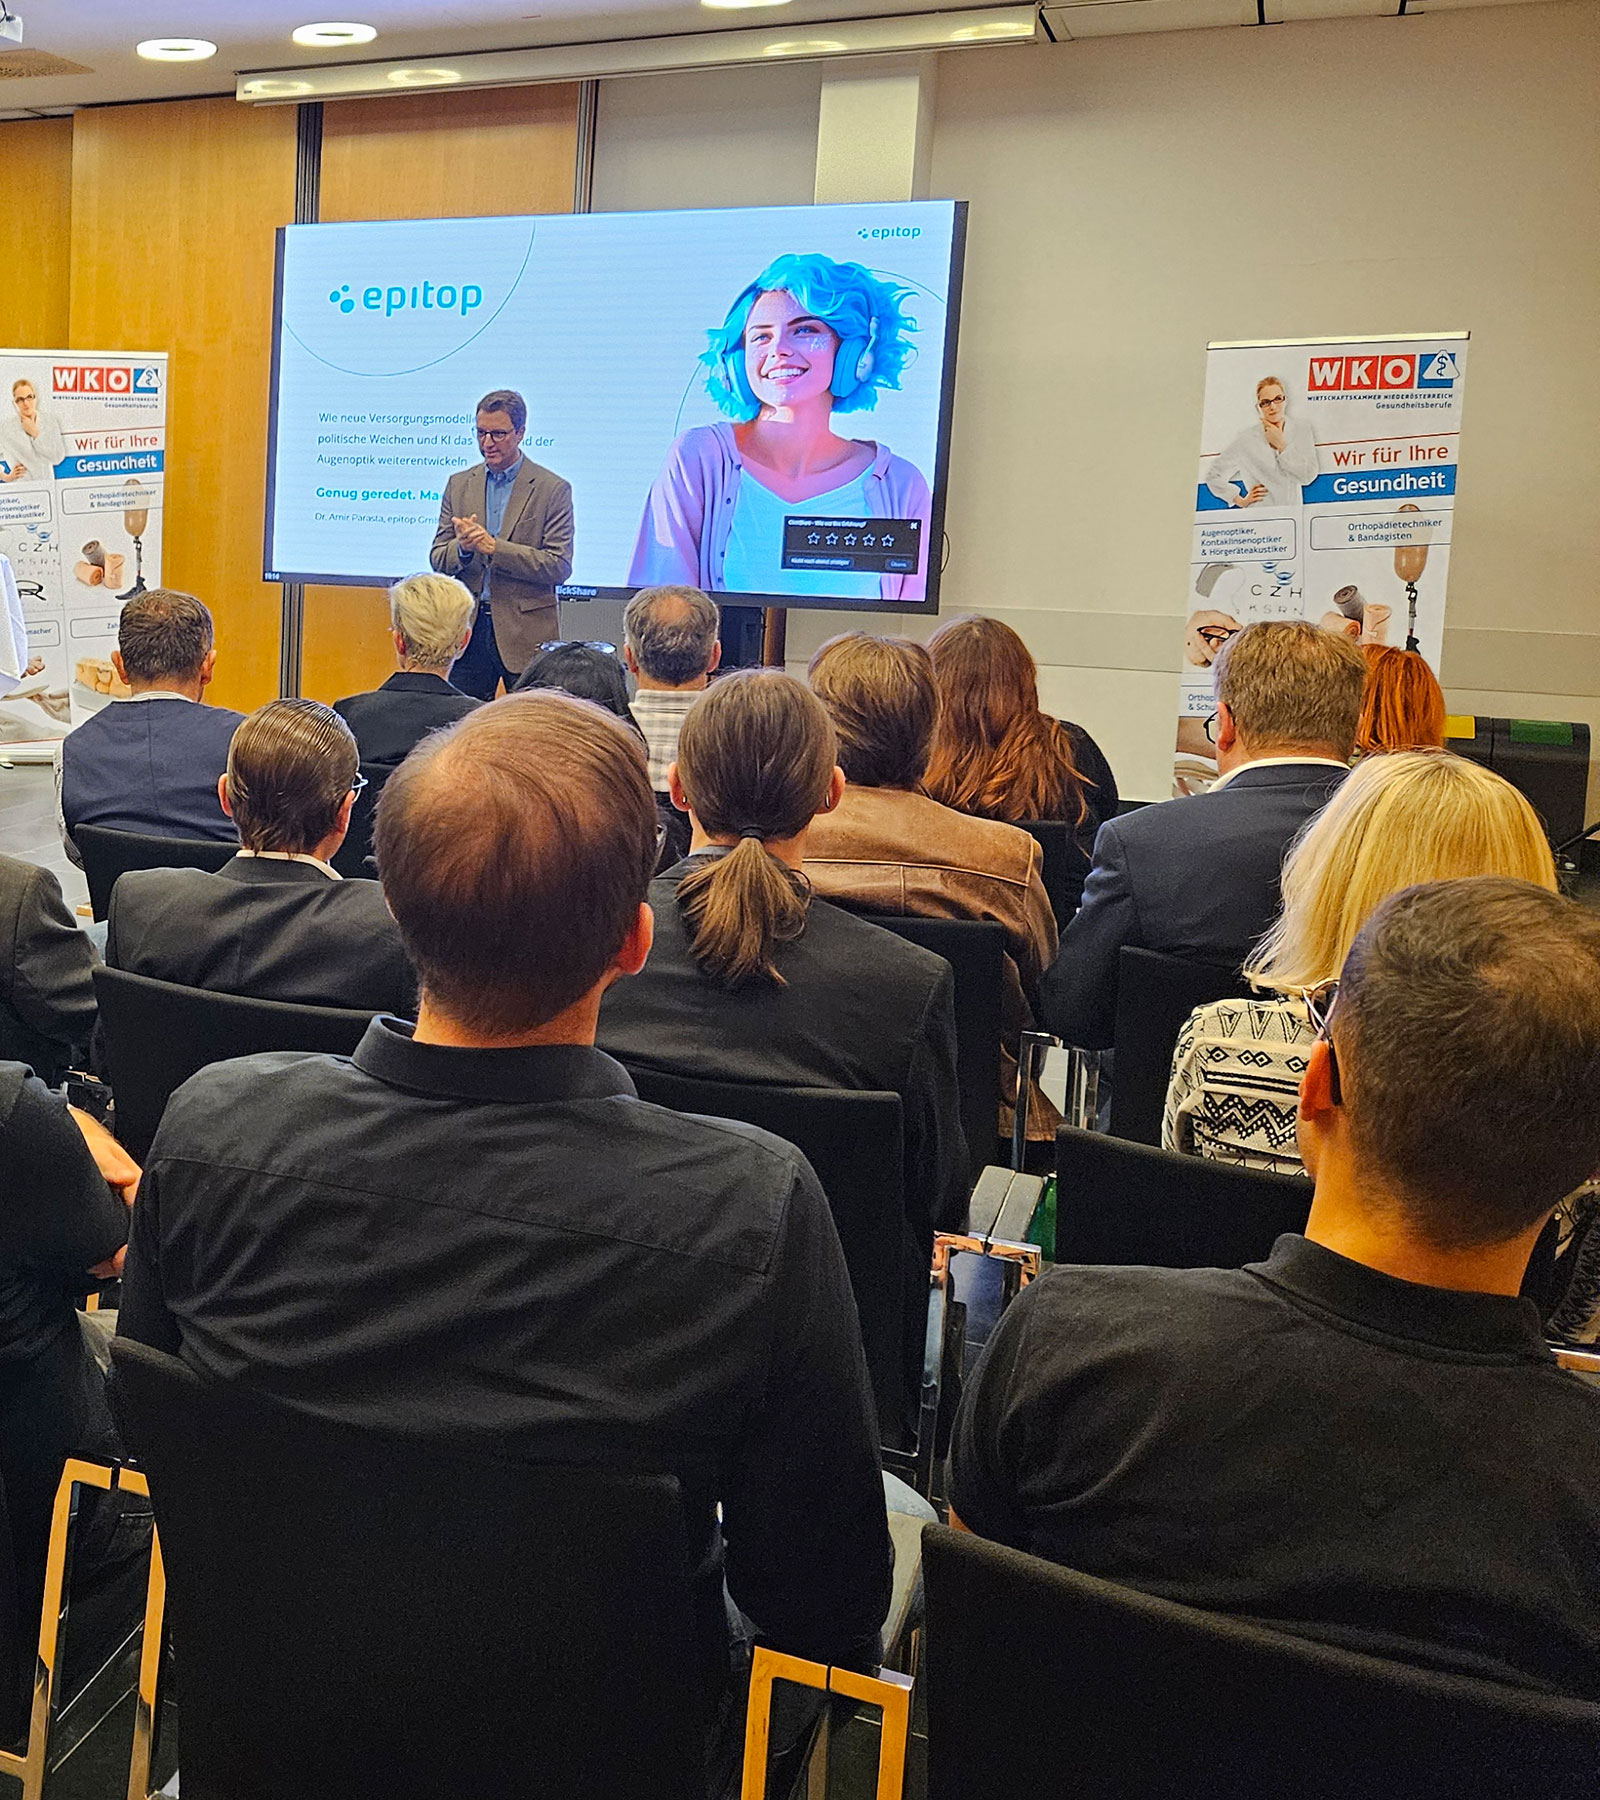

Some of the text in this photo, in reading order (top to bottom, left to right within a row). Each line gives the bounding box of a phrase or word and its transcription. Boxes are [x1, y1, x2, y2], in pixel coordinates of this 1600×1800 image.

[872, 226, 921, 240] epitop
[363, 280, 483, 317] epitop
[53, 368, 129, 391] WKO
[1311, 358, 1411, 387] WKO
[1376, 401, 1452, 409] Gesundheitsberufe
[319, 413, 338, 423] Wie
[340, 414, 366, 424] neue
[75, 434, 158, 451] Wir für Ihre
[318, 433, 367, 446] politische
[369, 434, 414, 445] Weichen
[416, 435, 437, 445] und
[441, 435, 451, 446] KI
[453, 435, 473, 446] das
[535, 436, 554, 447] der
[317, 454, 468, 467] Augenoptik weiterentwickeln
[1333, 445, 1449, 466] Wir für Ihre
[76, 455, 158, 473] Gesundheit
[1333, 471, 1446, 495] Gesundheit
[316, 487, 442, 502] Genug geredet. Ma
[97, 499, 136, 508] Bandagisten
[1348, 519, 1442, 532] Orthopädietechniker
[1201, 527, 1257, 539] Augenoptiker,
[1358, 531, 1412, 543] Bandagisten
[1209, 545, 1288, 557] Hörgeräteakustiker
[1188, 693, 1217, 702] Orthop
